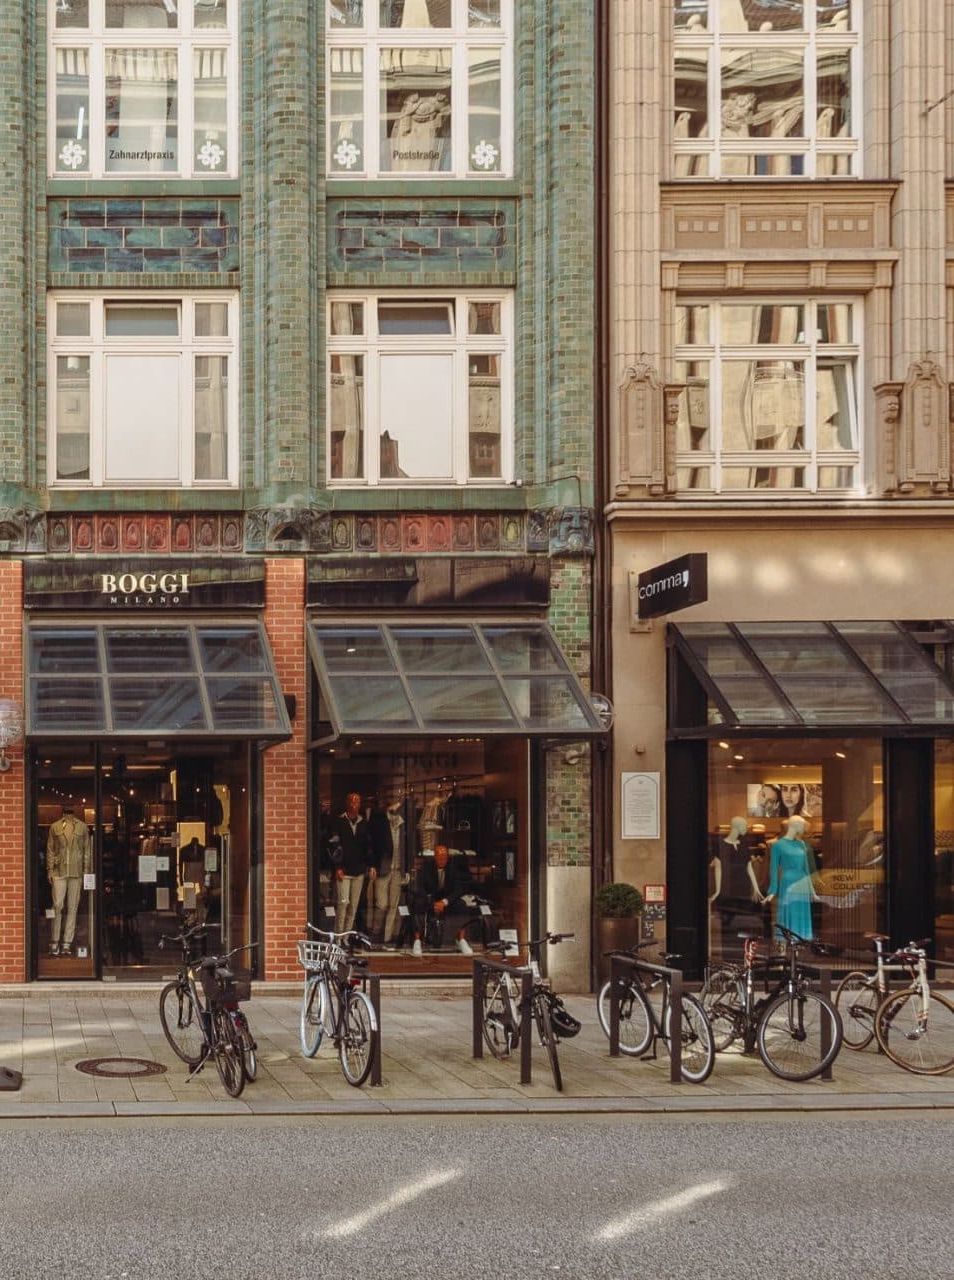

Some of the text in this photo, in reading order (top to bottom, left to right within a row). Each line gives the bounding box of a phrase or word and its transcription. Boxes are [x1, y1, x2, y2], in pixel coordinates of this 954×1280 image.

[109, 150, 174, 162] Zahnarztpraxis
[393, 150, 440, 161] Poststraße
[101, 573, 190, 594] BOGGI
